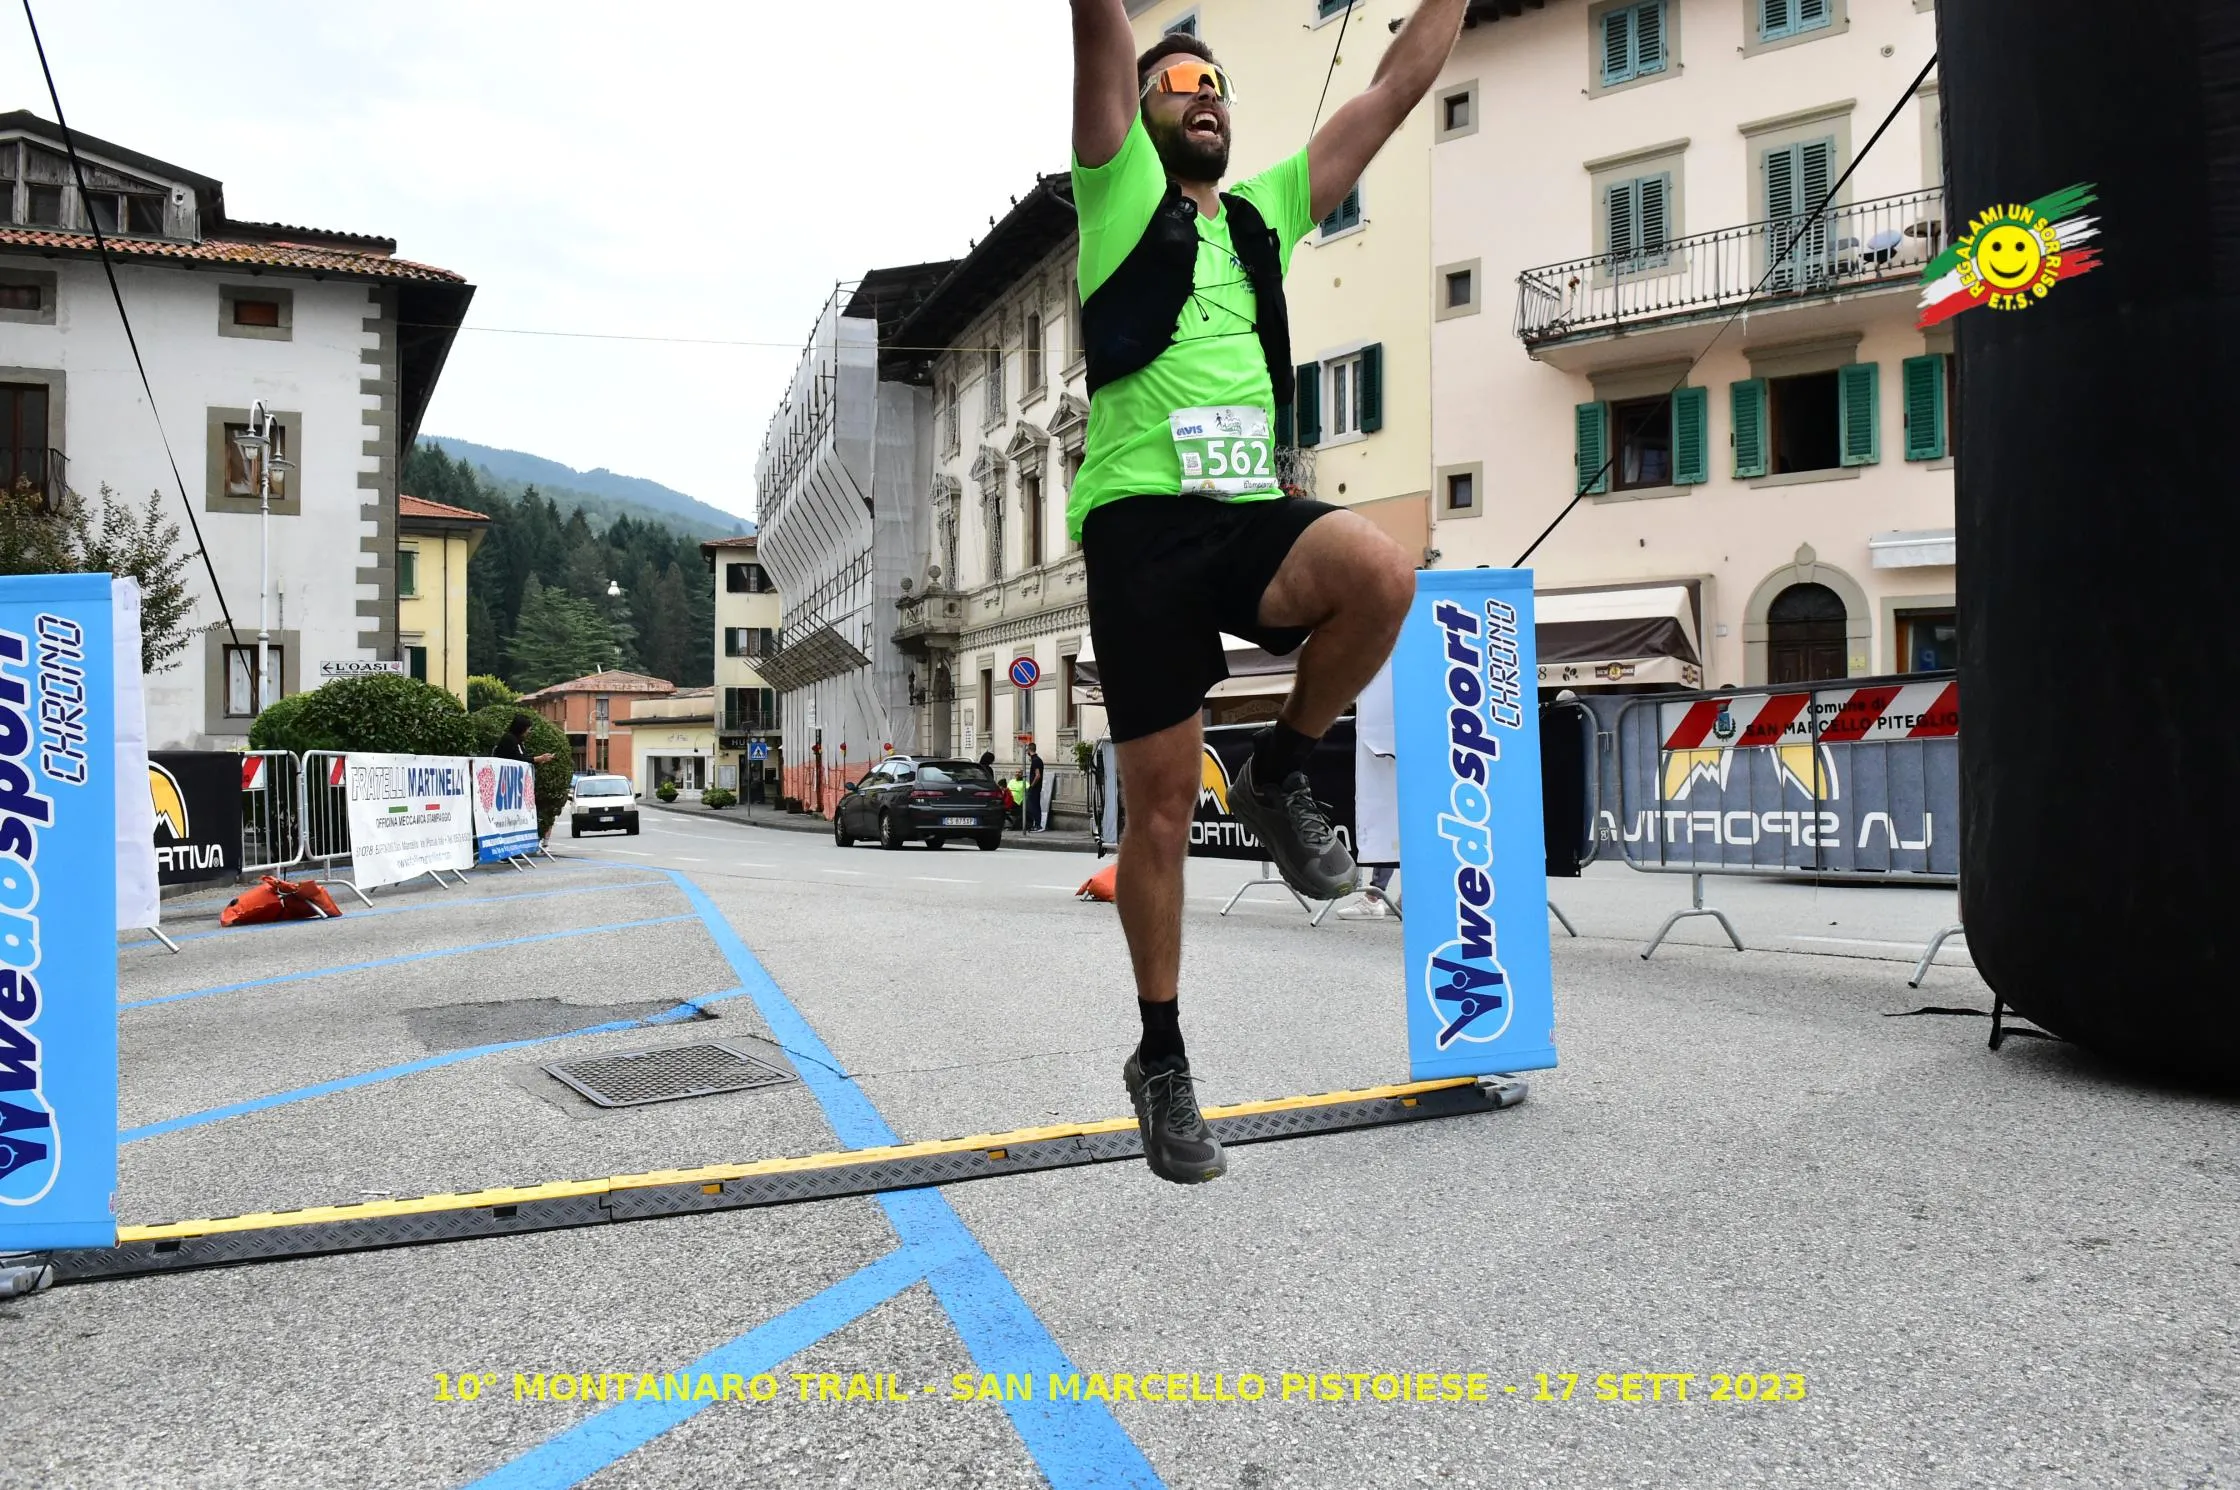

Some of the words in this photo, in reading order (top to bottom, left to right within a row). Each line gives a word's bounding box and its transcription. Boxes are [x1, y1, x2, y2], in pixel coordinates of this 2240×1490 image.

[1176, 424, 1204, 437] AVIS
[1207, 440, 1271, 476] 562
[335, 663, 387, 671] L'OASI
[1486, 600, 1522, 729] CHRONO
[36, 613, 87, 786] CHRONO
[1746, 722, 1778, 737] SAN
[1877, 711, 1960, 730] PITEGLIO
[351, 766, 406, 801] FRATELLI
[408, 767, 465, 798] MARTINELLI
[496, 765, 524, 811] AVIS
[1434, 600, 1499, 959] wedosport
[155, 844, 224, 871] RTIVA
